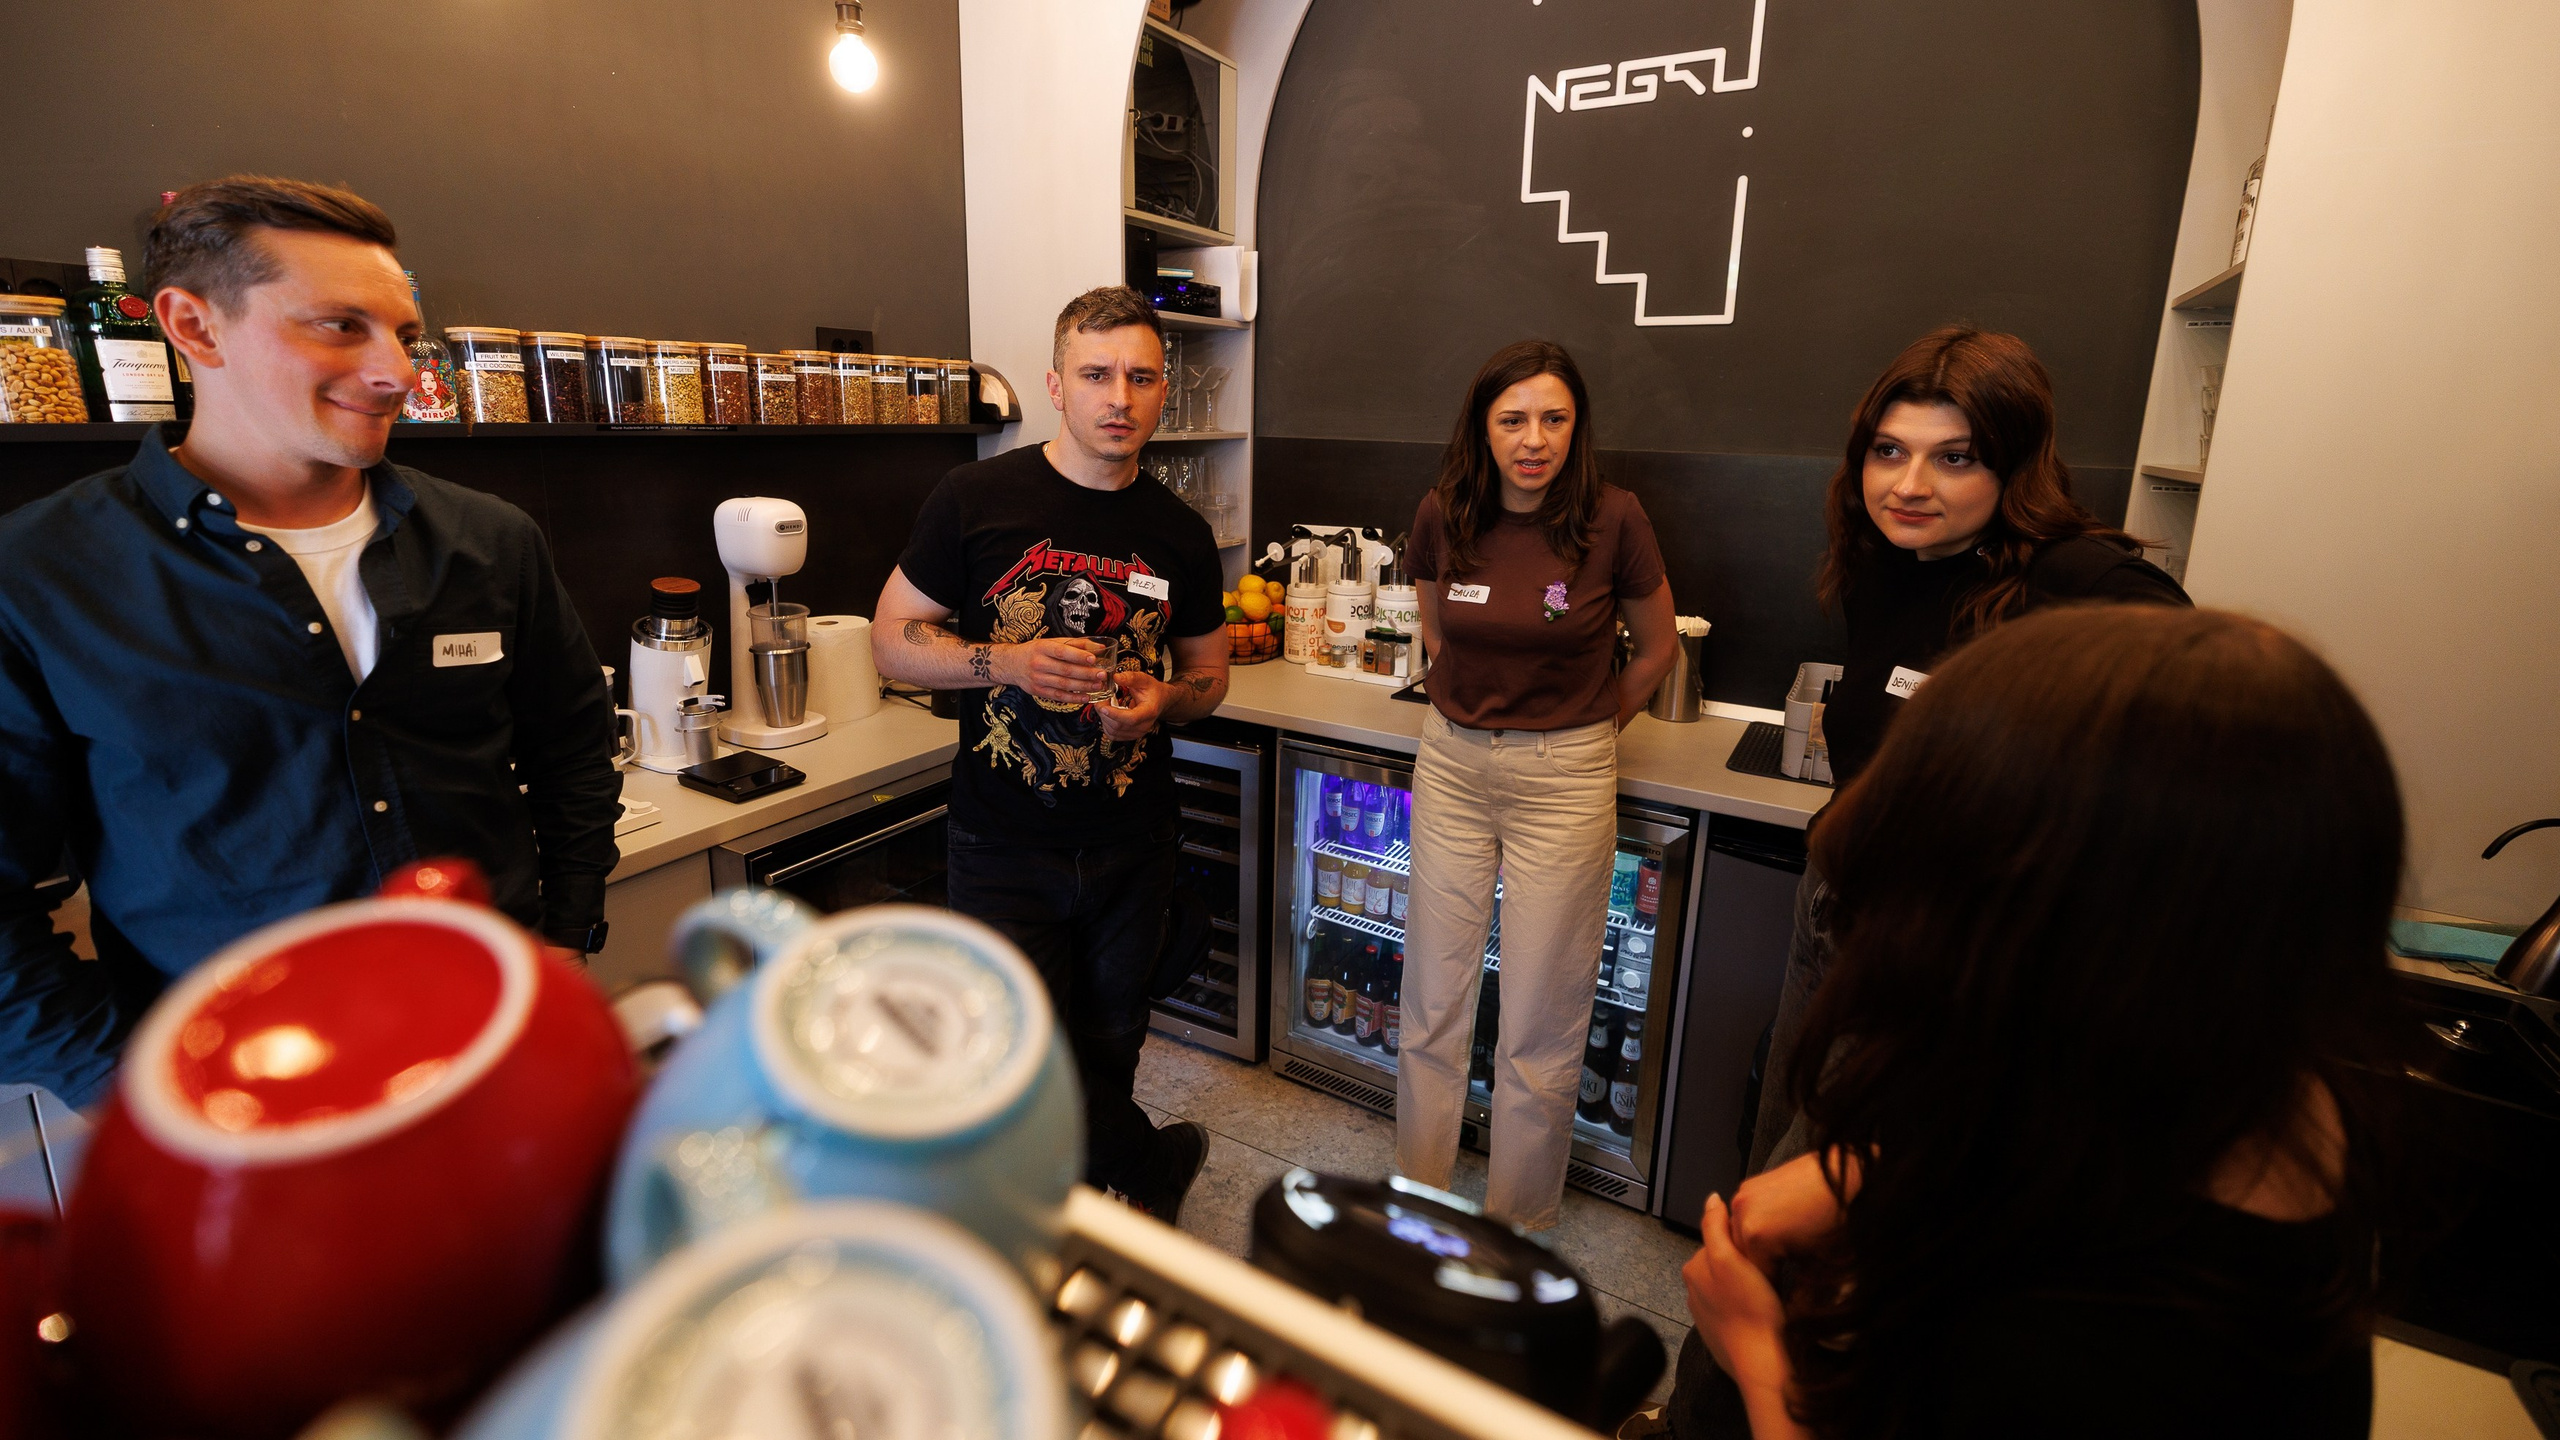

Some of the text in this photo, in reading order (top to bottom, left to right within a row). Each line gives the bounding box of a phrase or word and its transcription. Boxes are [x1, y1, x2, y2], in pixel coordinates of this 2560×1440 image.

[1142, 34, 1154, 52] ata
[17, 326, 49, 335] ALUNE
[422, 408, 455, 419] BIRLOU
[1132, 578, 1157, 592] ALEX
